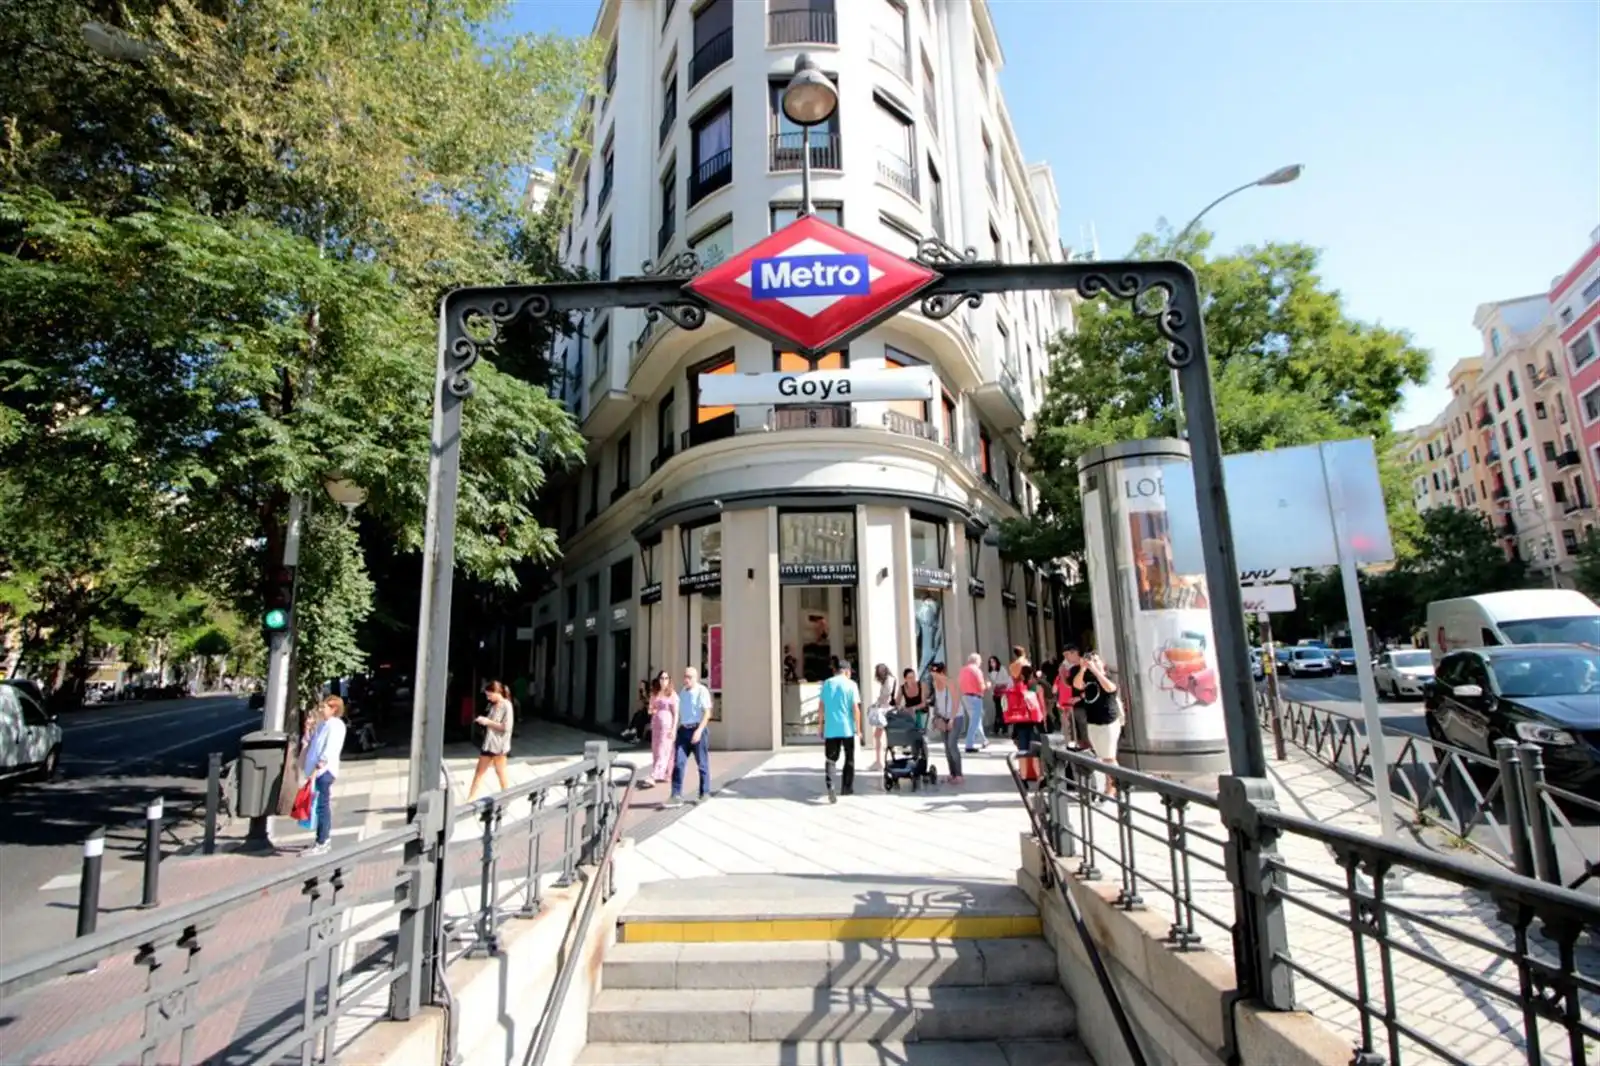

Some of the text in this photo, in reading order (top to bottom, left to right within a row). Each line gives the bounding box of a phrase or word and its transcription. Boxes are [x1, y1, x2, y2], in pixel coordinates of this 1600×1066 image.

[761, 261, 861, 290] Metro
[778, 376, 851, 400] Goya
[781, 563, 857, 575] intimissimi
